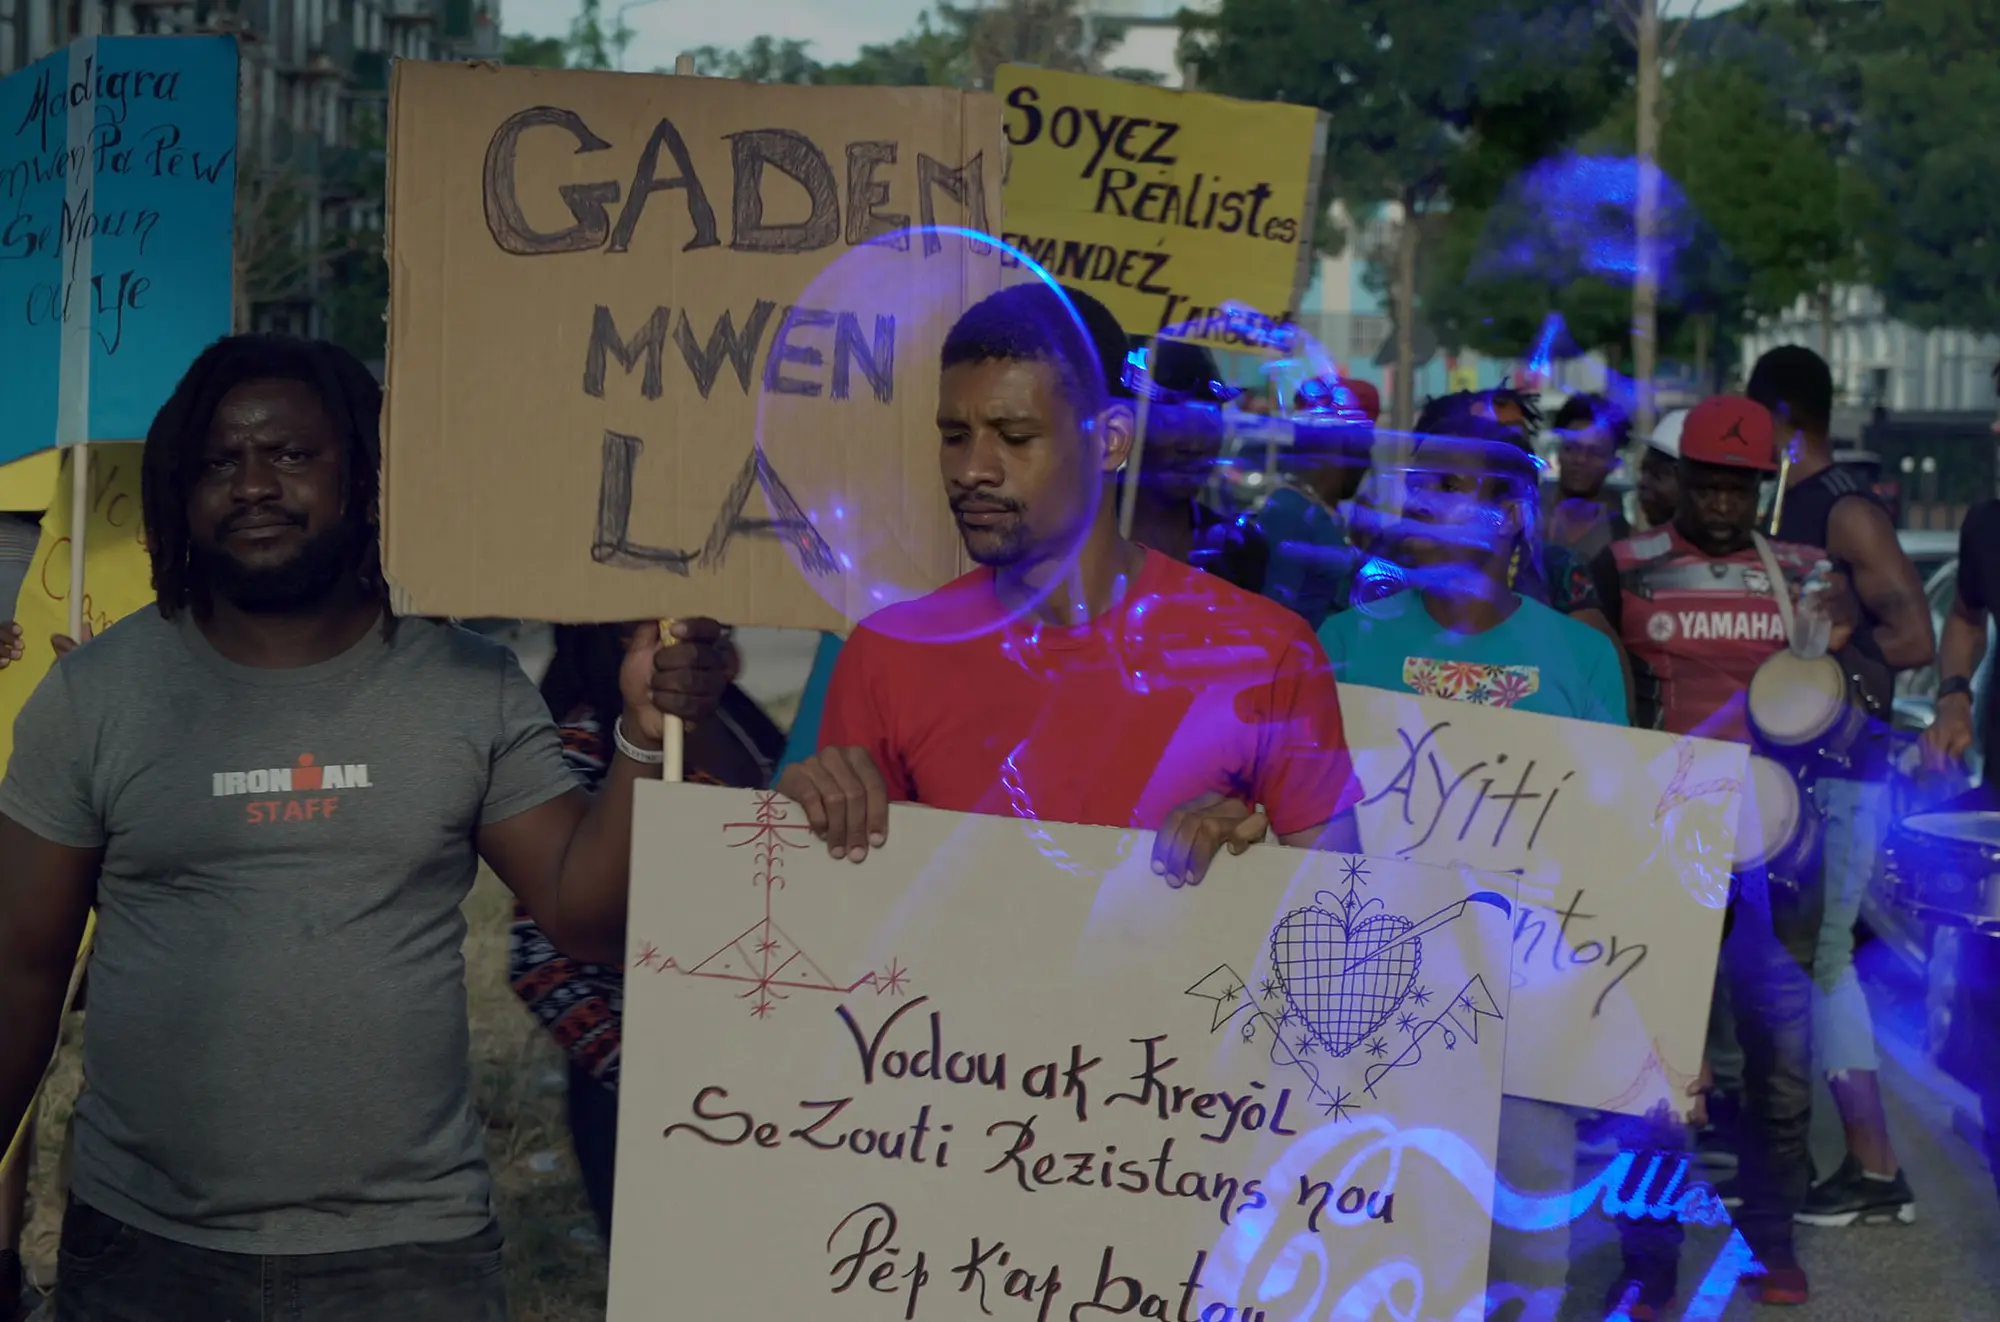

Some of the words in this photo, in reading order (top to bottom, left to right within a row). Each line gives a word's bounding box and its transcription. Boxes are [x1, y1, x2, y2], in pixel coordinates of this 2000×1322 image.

[582, 298, 895, 403] MWEN
[590, 428, 840, 577] LA
[1678, 611, 1786, 641] YAMAHA
[245, 797, 340, 824] STAFF
[834, 996, 1006, 1091] Vodou
[1021, 1044, 1103, 1122] ak
[663, 1086, 781, 1148] Se
[789, 1097, 954, 1168] Zouti
[983, 1114, 1268, 1226] Rezistans
[1297, 1174, 1395, 1231] nou
